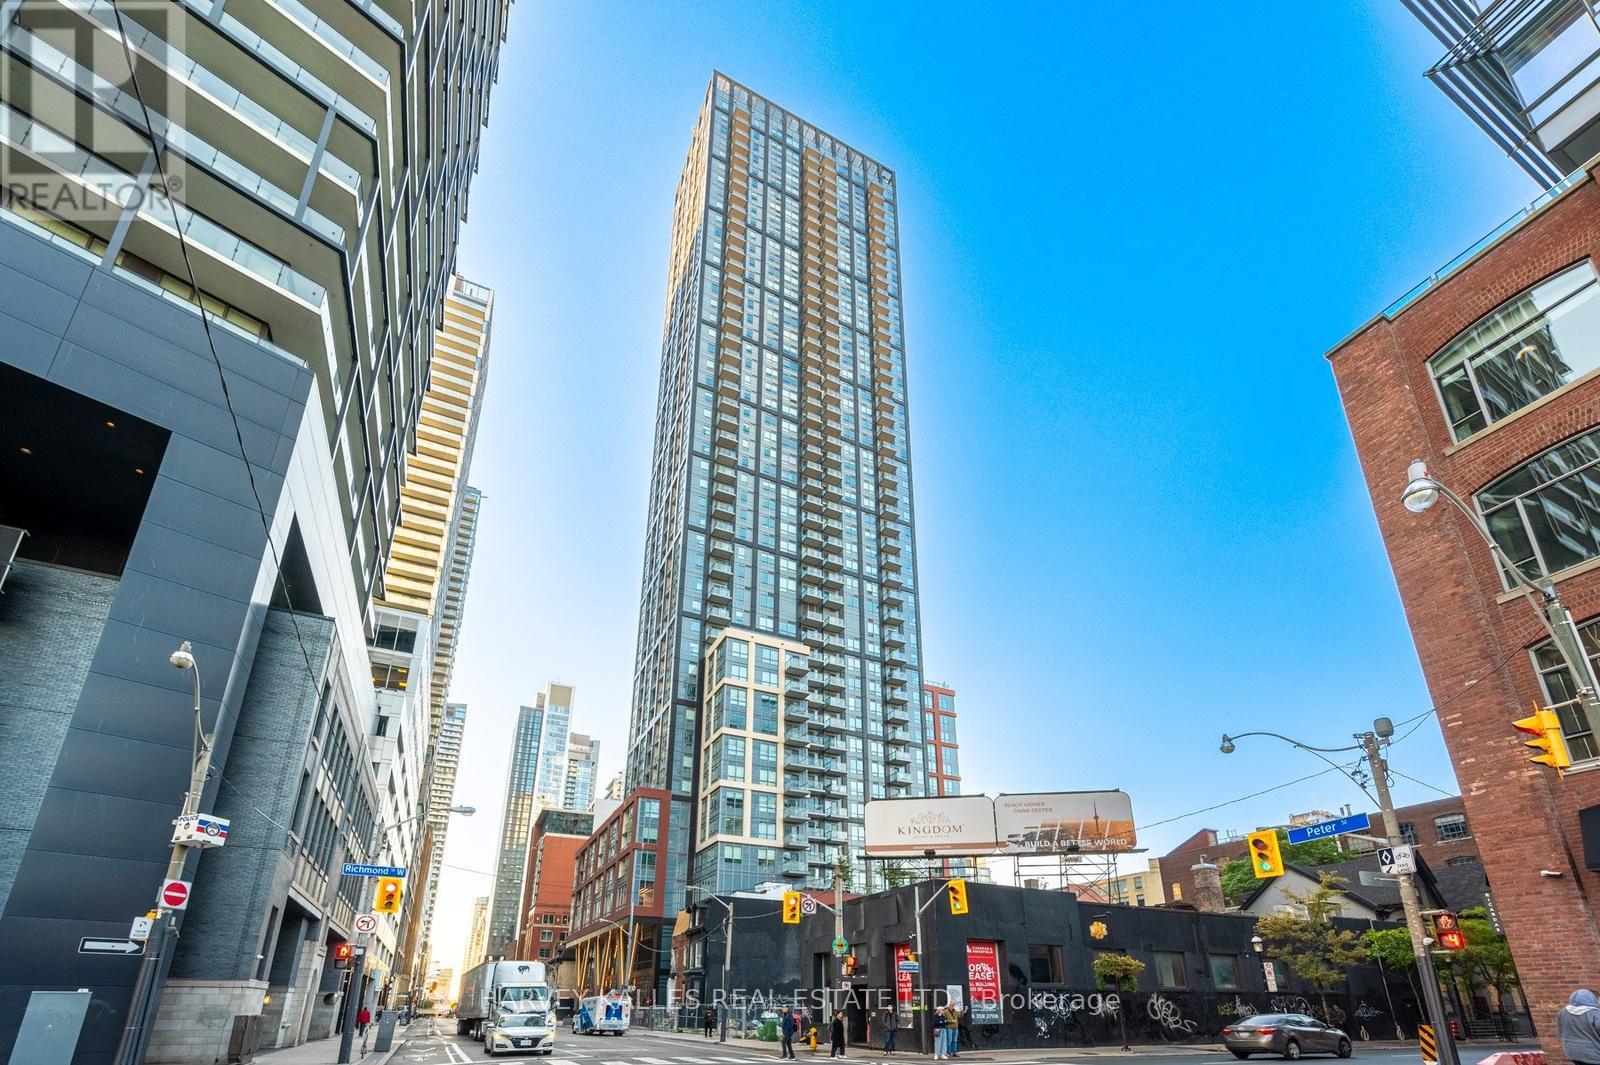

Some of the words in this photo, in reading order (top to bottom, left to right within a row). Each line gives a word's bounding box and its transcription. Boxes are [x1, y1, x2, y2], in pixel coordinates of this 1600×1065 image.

[897, 825, 962, 835] KINGDOM
[1306, 823, 1336, 837] Peter
[1024, 840, 1050, 848] BUILD
[1052, 840, 1059, 848] A
[1060, 839, 1093, 847] BETTER
[1094, 838, 1128, 846] WORLD
[345, 864, 389, 875] Richmond
[969, 963, 982, 972] OR
[969, 972, 992, 980] EASE
